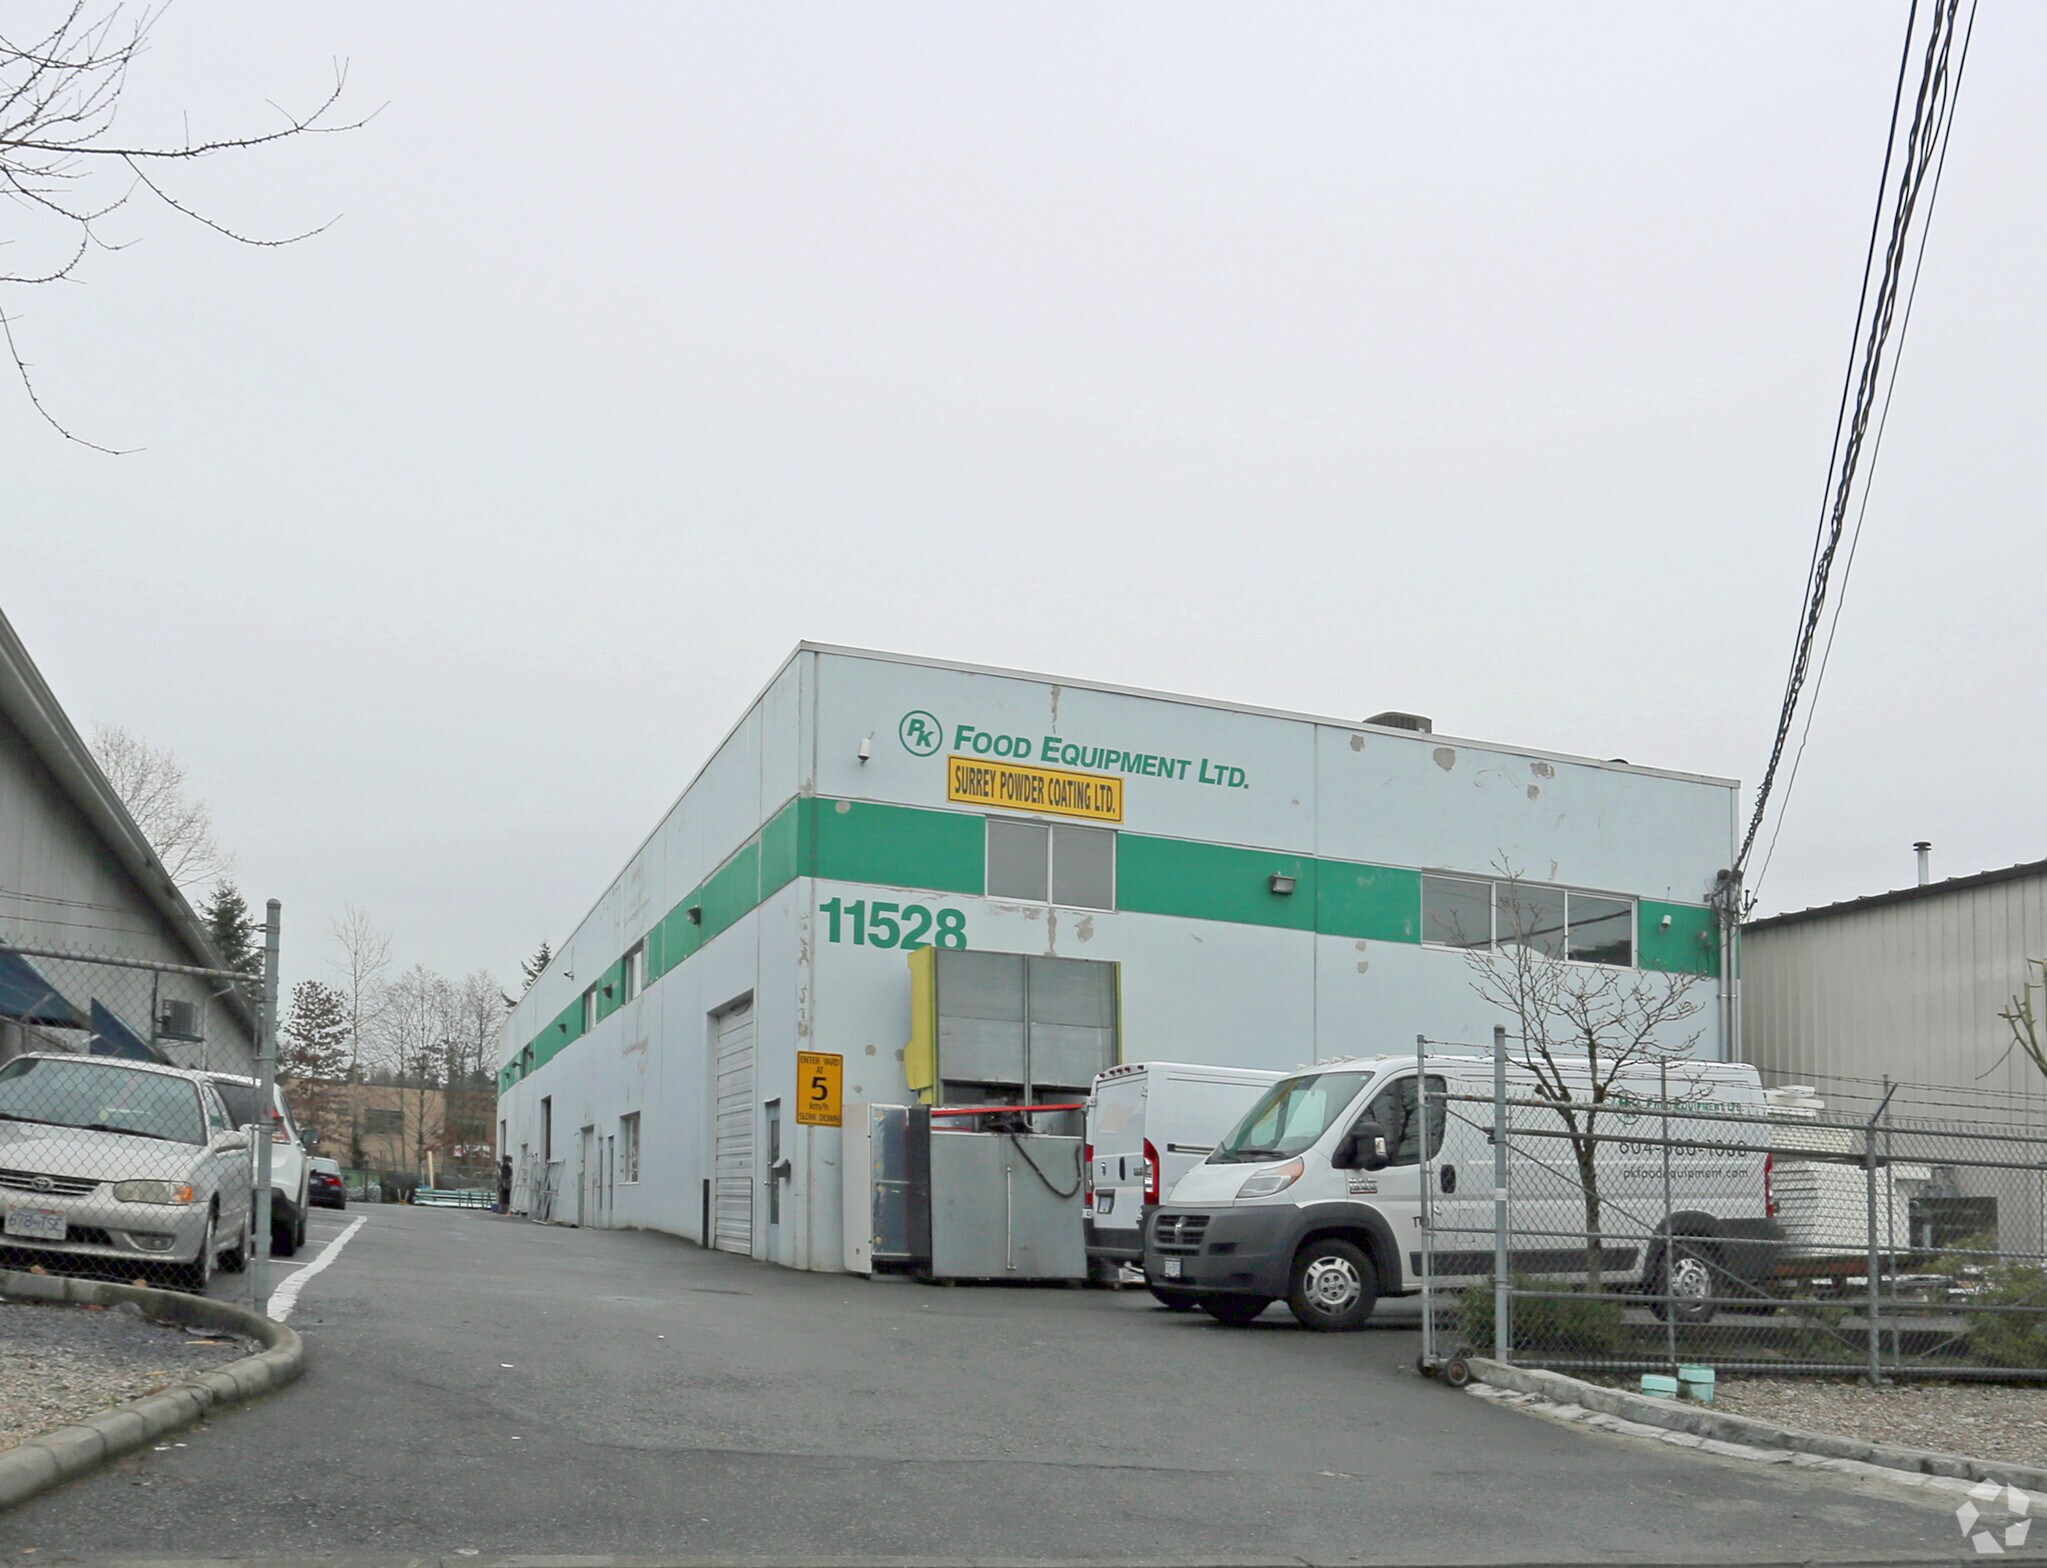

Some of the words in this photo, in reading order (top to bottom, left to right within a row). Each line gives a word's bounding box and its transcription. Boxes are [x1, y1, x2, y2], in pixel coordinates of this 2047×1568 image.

[953, 724, 1032, 759] FOOD
[1040, 736, 1192, 780] EQUIPMENT
[1198, 758, 1249, 790] LTD.
[954, 765, 997, 798] SURREY
[1000, 770, 1044, 805] POWDER
[1048, 777, 1091, 811] COATING
[1094, 783, 1116, 814] LTD.
[819, 897, 967, 951] 11528
[800, 1055, 820, 1065] ENTER
[824, 1057, 840, 1067] YARD
[811, 1076, 828, 1101] 5
[799, 1111, 817, 1121] SLOW
[819, 1113, 840, 1123] DOWN
[1623, 1166, 1749, 1181] pkfoodquipment.com
